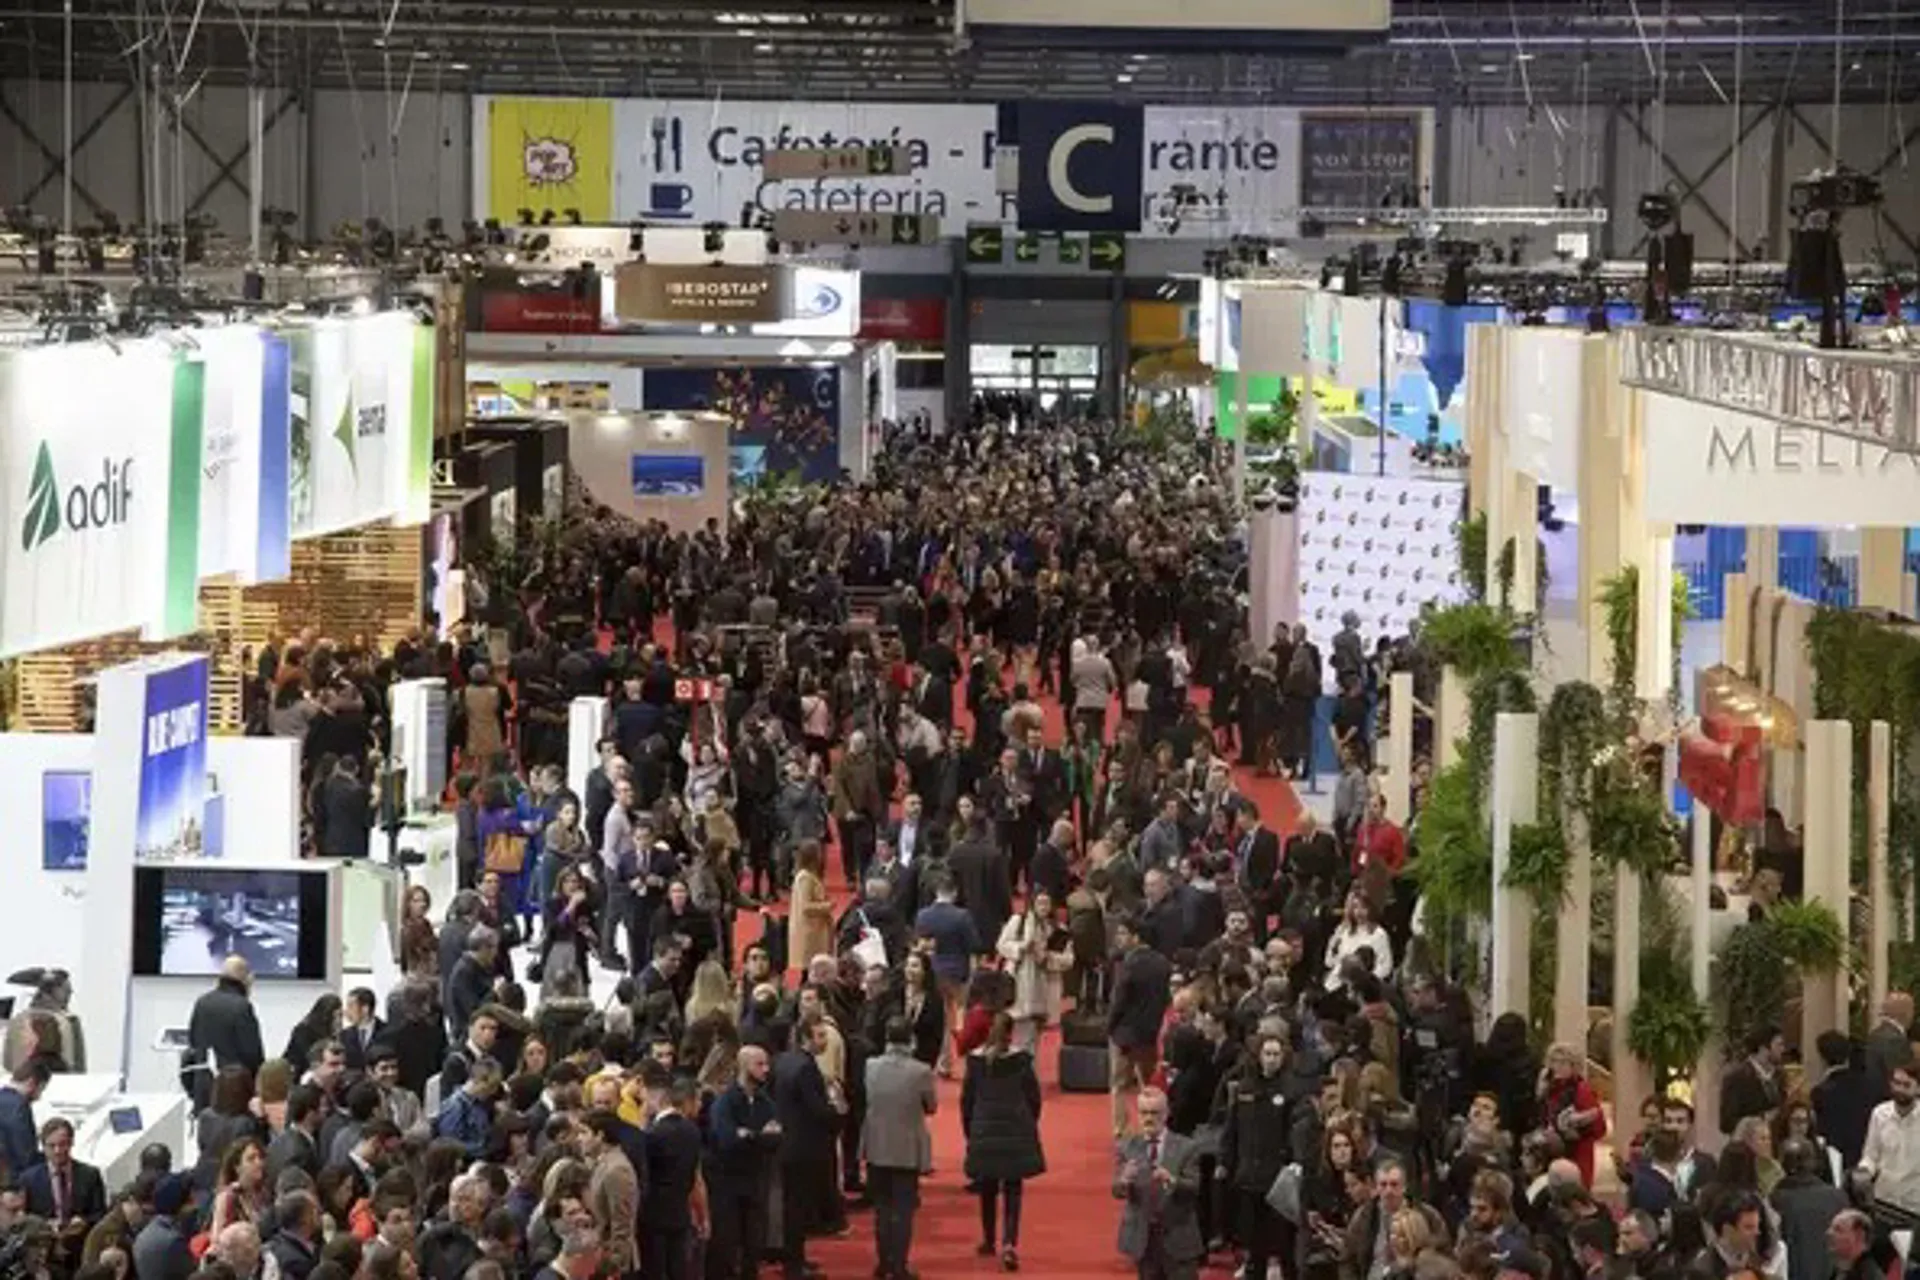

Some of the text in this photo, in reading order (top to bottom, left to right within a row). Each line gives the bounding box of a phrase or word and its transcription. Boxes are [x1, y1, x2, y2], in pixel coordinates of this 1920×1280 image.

[756, 176, 946, 217] Cafeteria
[1047, 123, 1113, 213] C
[665, 282, 760, 294] IBEROSTAR
[67, 457, 134, 531] adif
